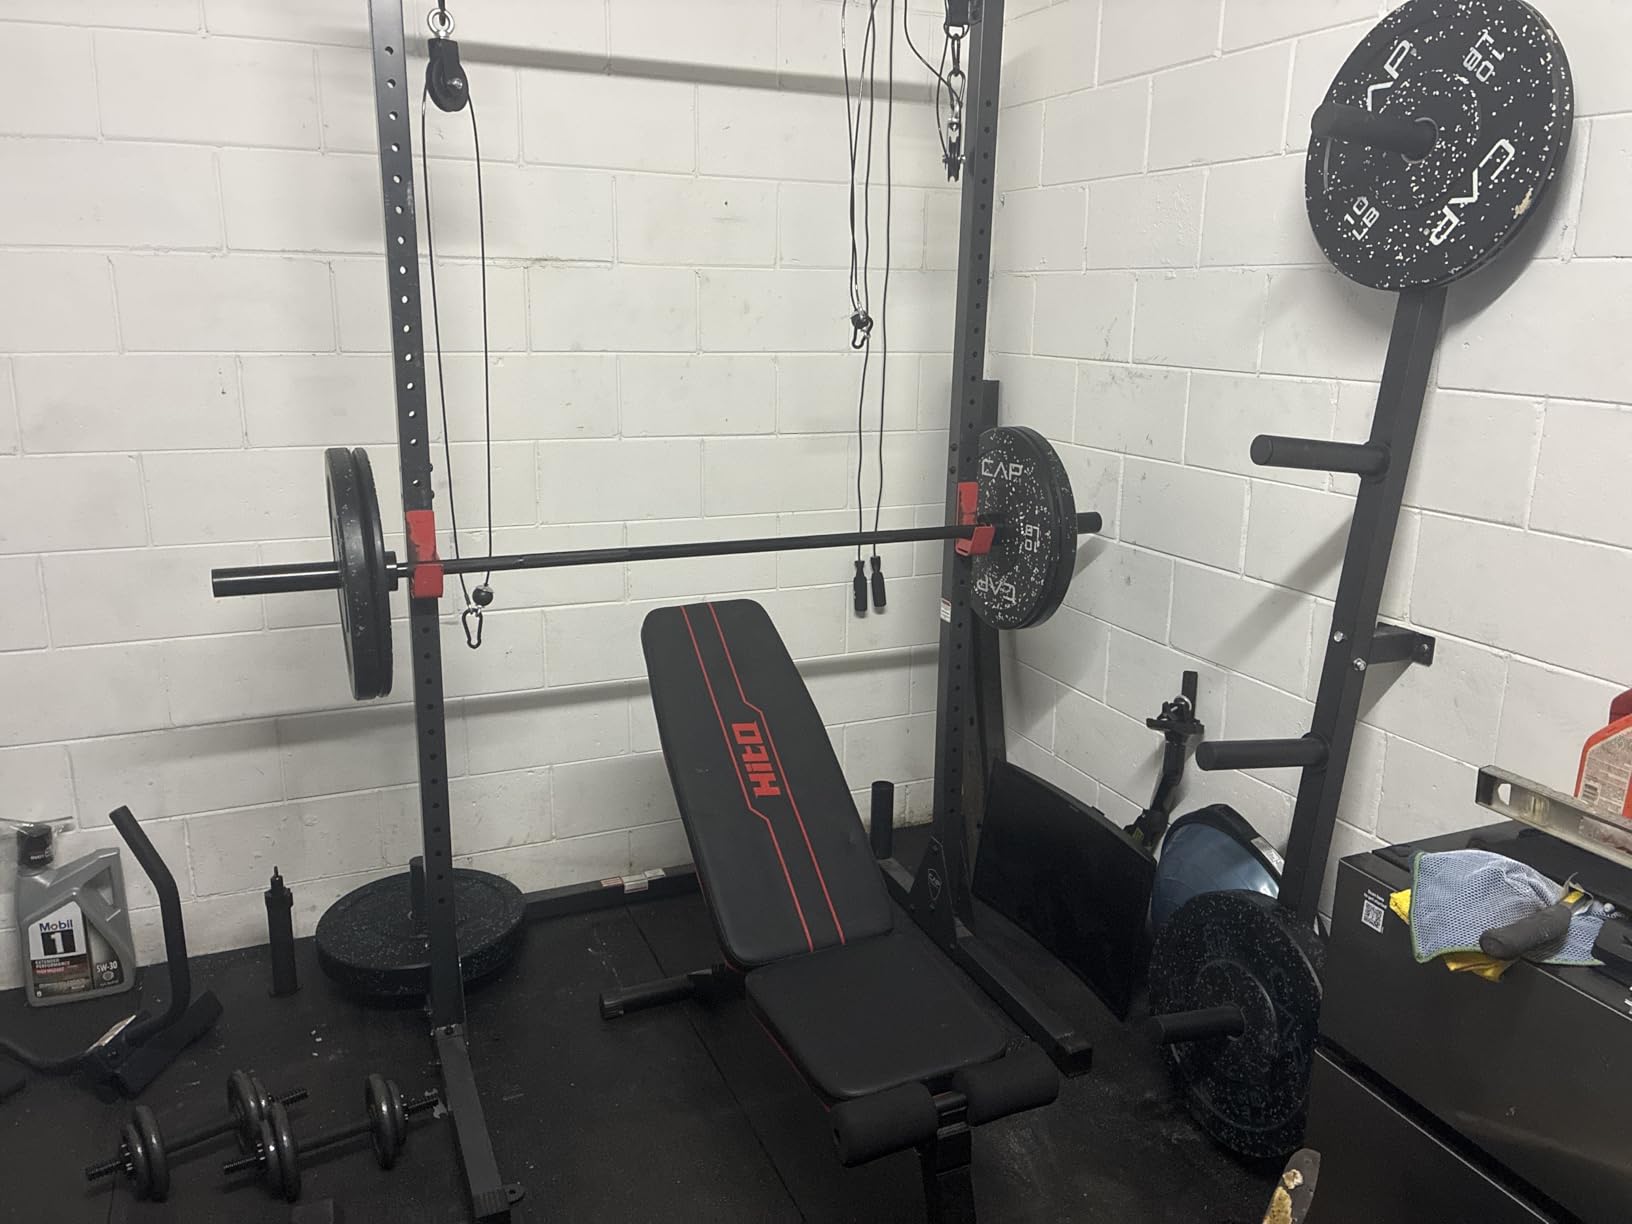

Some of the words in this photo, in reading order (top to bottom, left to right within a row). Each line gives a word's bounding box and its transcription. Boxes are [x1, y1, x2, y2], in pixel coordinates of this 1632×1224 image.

[1463, 28, 1495, 72] LB
[1366, 39, 1412, 112] AP
[1476, 48, 1505, 83] 10
[1429, 138, 1516, 246] CAP
[1344, 196, 1369, 226] 10
[1352, 207, 1380, 241] LB
[981, 458, 1024, 481] CAP
[976, 574, 1017, 603] CAP
[39, 919, 74, 932] Mobil
[50, 932, 65, 954] 1
[96, 960, 118, 973] 5W-30
